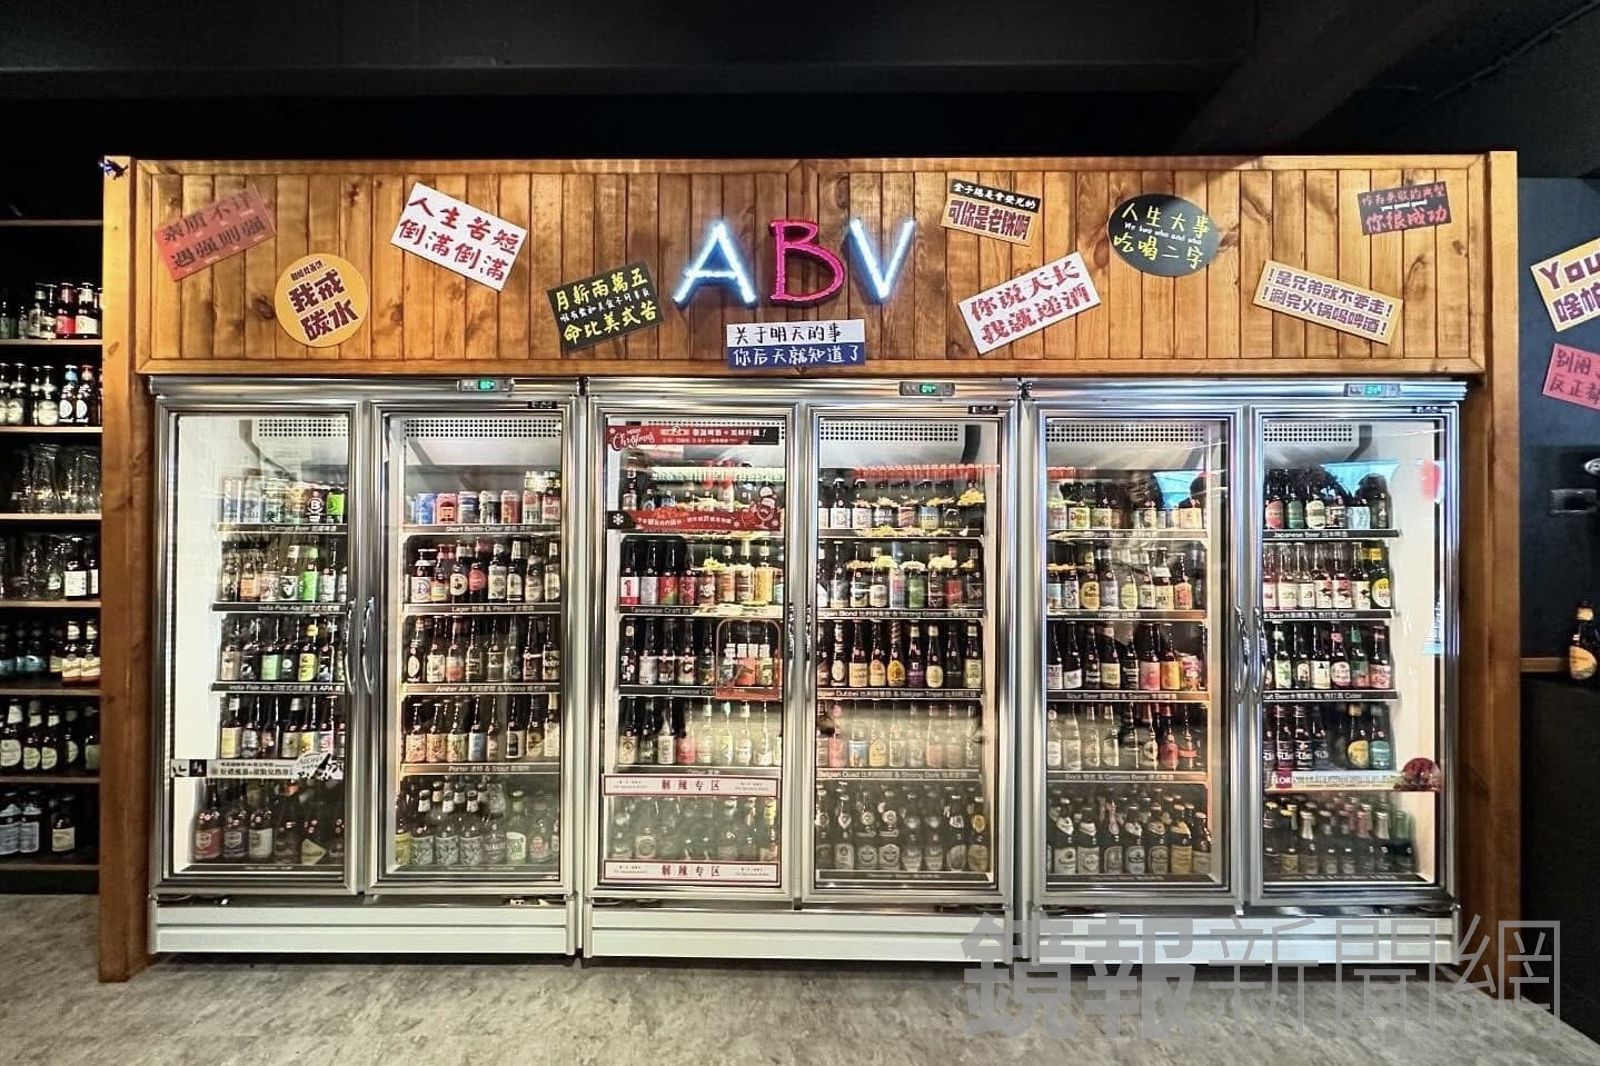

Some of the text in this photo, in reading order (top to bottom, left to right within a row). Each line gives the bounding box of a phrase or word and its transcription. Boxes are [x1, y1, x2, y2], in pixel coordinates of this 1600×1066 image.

[408, 197, 519, 256] 人生苦短
[1121, 202, 1211, 239] 人生大事
[1365, 209, 1448, 234] 你很成功
[672, 218, 916, 309] ABV
[1113, 232, 1204, 269] 吃喝二字
[288, 268, 345, 313] 我戒
[970, 260, 1081, 322] 你说天长
[299, 299, 359, 342] 碳水
[563, 300, 658, 346] 命比美式苦
[735, 324, 842, 345] 关于明天的事
[733, 345, 860, 366] 你后天就知道了
